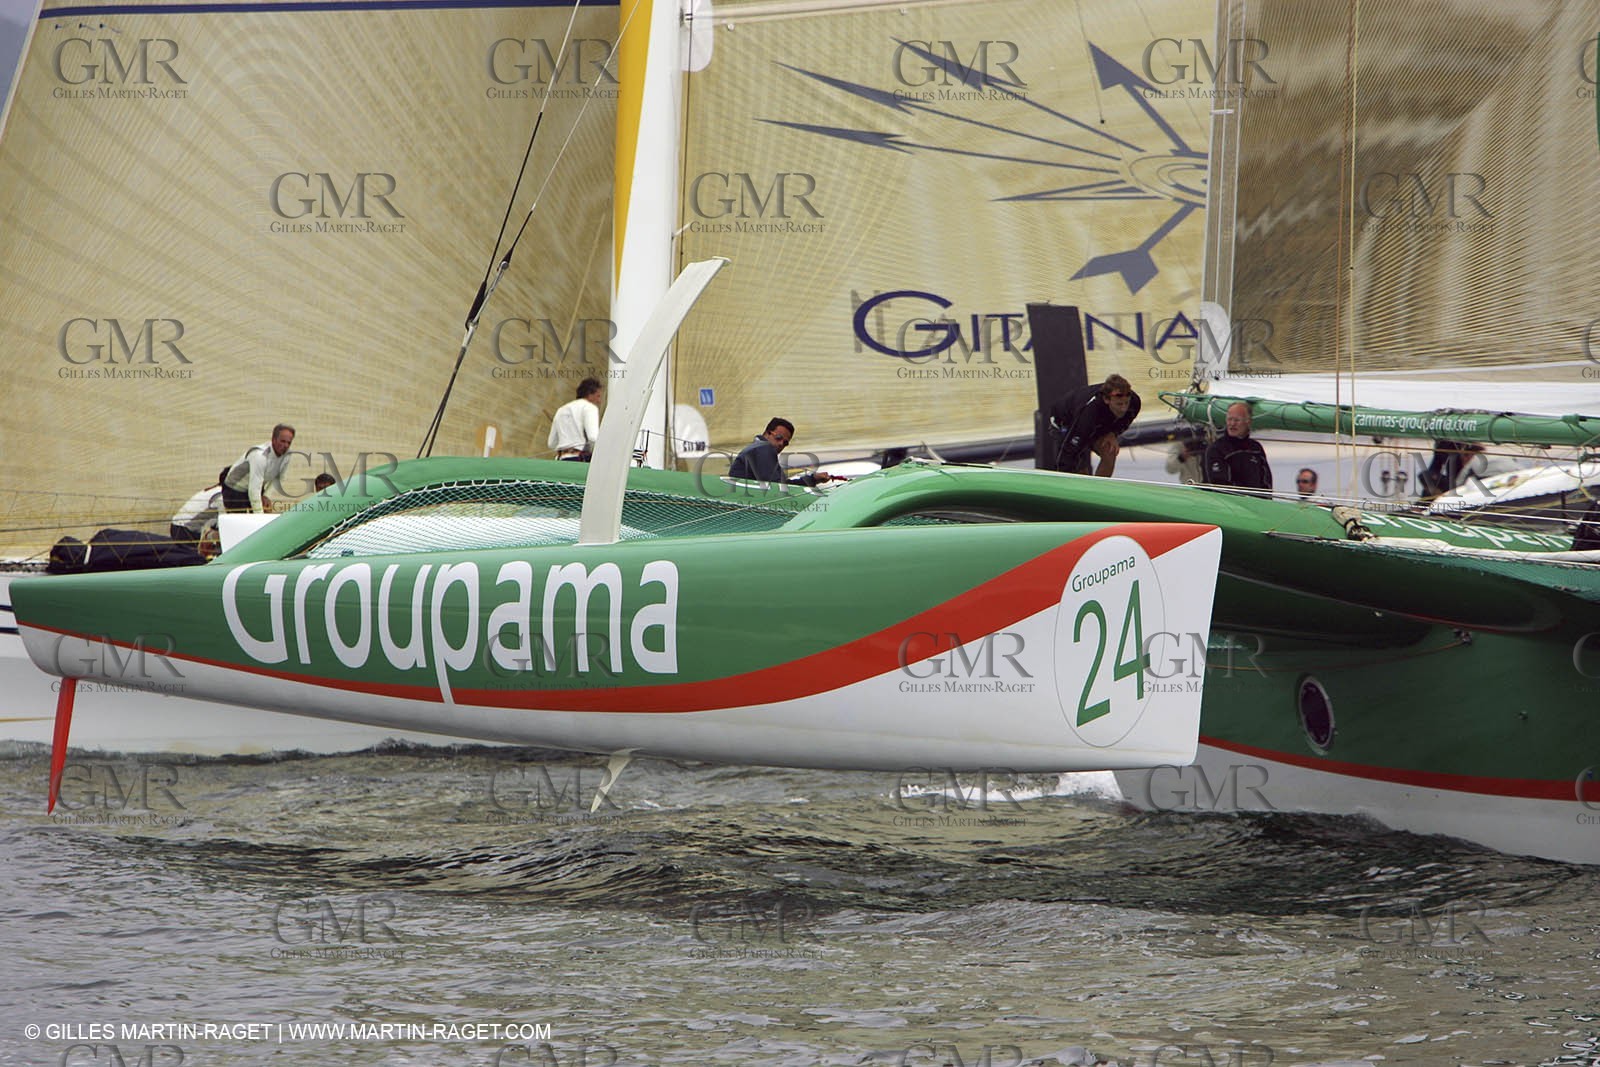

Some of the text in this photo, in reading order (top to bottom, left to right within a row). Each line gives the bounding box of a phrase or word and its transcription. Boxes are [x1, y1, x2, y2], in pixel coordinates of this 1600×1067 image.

[853, 290, 1198, 358] GITNA
[1072, 556, 1136, 593] Groupama
[222, 560, 679, 704] Groupama
[1073, 580, 1150, 727] 24
